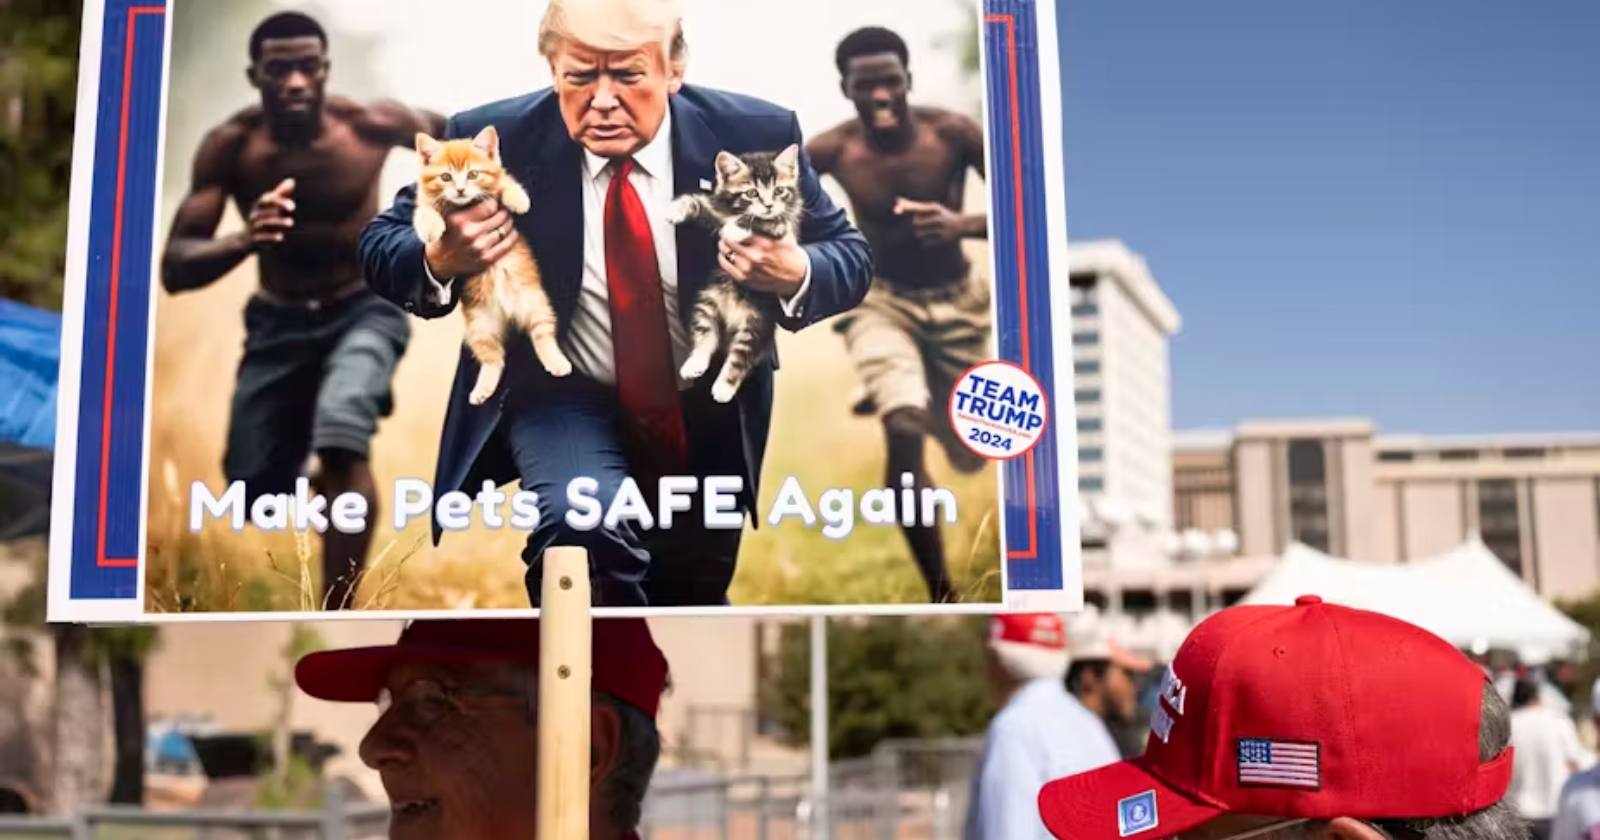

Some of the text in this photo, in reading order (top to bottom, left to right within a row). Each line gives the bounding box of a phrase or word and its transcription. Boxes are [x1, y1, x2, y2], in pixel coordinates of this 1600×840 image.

[956, 391, 1043, 431] TRUMP
[969, 374, 1039, 412] TEAM
[968, 427, 1012, 450] 2024
[188, 471, 958, 540] Make Pets SAFE Again
